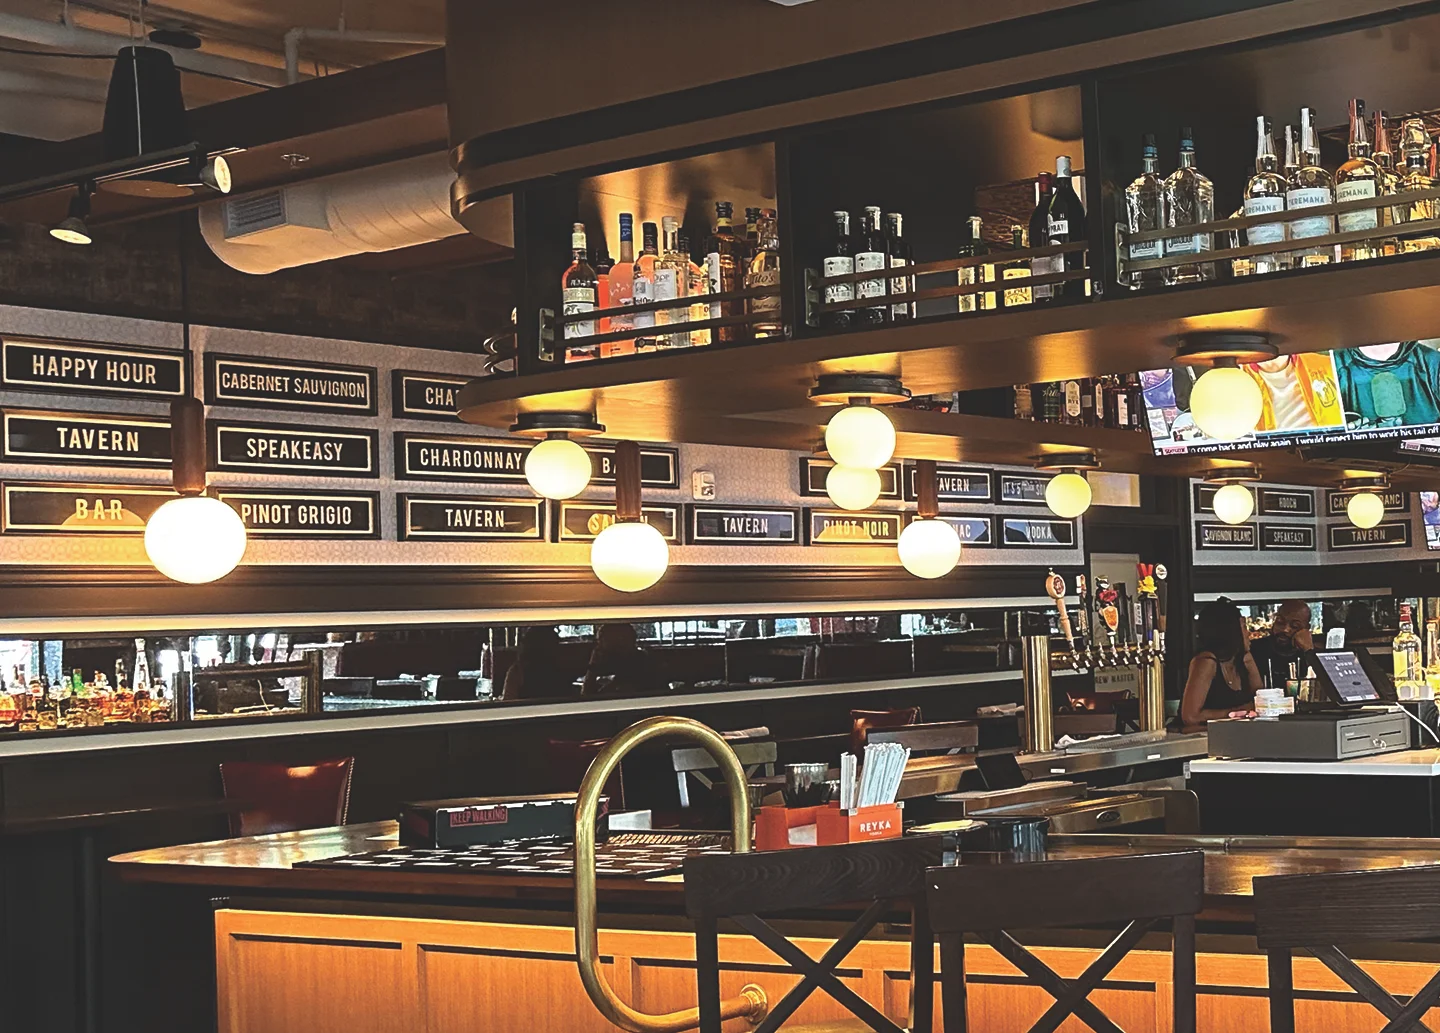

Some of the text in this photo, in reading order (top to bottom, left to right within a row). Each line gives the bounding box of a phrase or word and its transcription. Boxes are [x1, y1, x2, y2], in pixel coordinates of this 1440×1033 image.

[32, 354, 156, 384] HAPPY HOUR
[222, 372, 365, 398] CABERNET SAUVIGNON
[425, 386, 460, 406] CHA
[57, 427, 139, 452] TAVERN
[246, 438, 342, 462] SPEAKEASY
[420, 448, 522, 470] CHARDONNAY
[937, 478, 970, 492] AVERN
[76, 498, 122, 520] BAR
[242, 503, 352, 525] PINOT GRIGIO
[445, 508, 505, 528] TAVERN
[722, 517, 768, 534] TAVERN
[824, 520, 890, 536] PINOT NOIR
[1026, 525, 1052, 539] VODKA
[1274, 531, 1304, 543] SPEAKEASY
[1352, 530, 1386, 542] TAVERN
[452, 808, 506, 824] KEEP WALKING
[860, 820, 891, 832] REYKA
